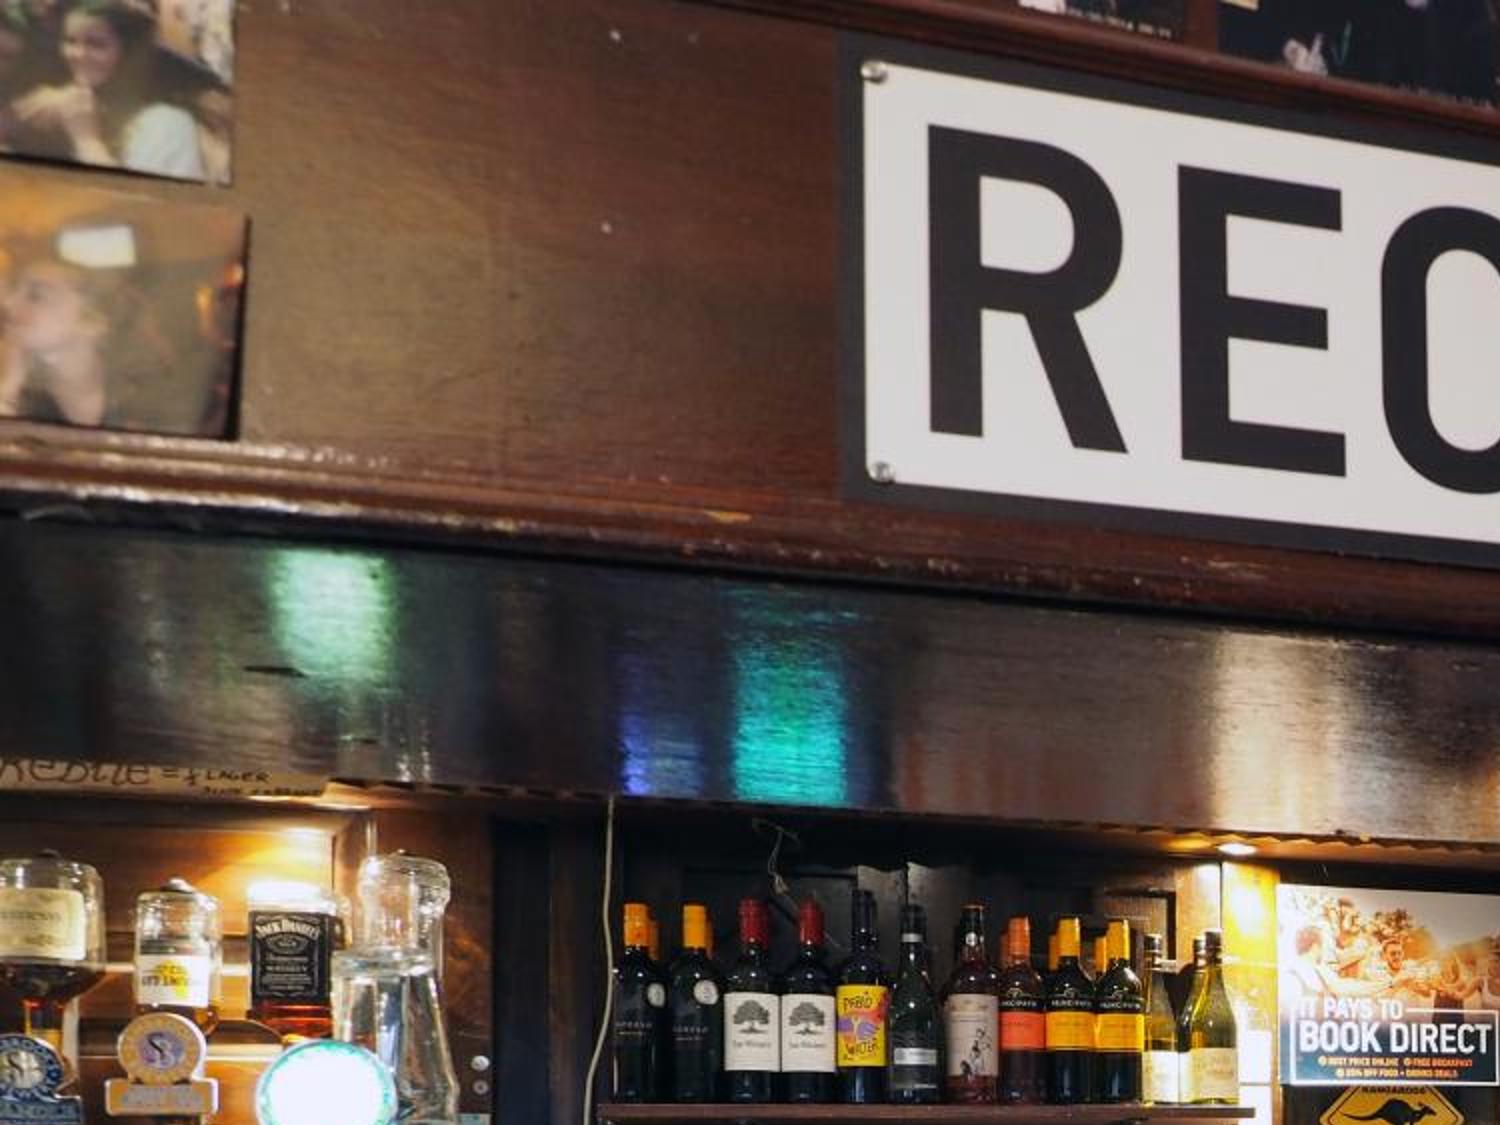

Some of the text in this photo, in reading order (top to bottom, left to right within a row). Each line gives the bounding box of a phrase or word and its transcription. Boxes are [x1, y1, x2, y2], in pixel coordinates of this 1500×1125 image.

[1324, 998, 1374, 1020] PAYS
[1378, 998, 1404, 1020] TO
[1298, 1021, 1493, 1054] BOOK DIRECT
